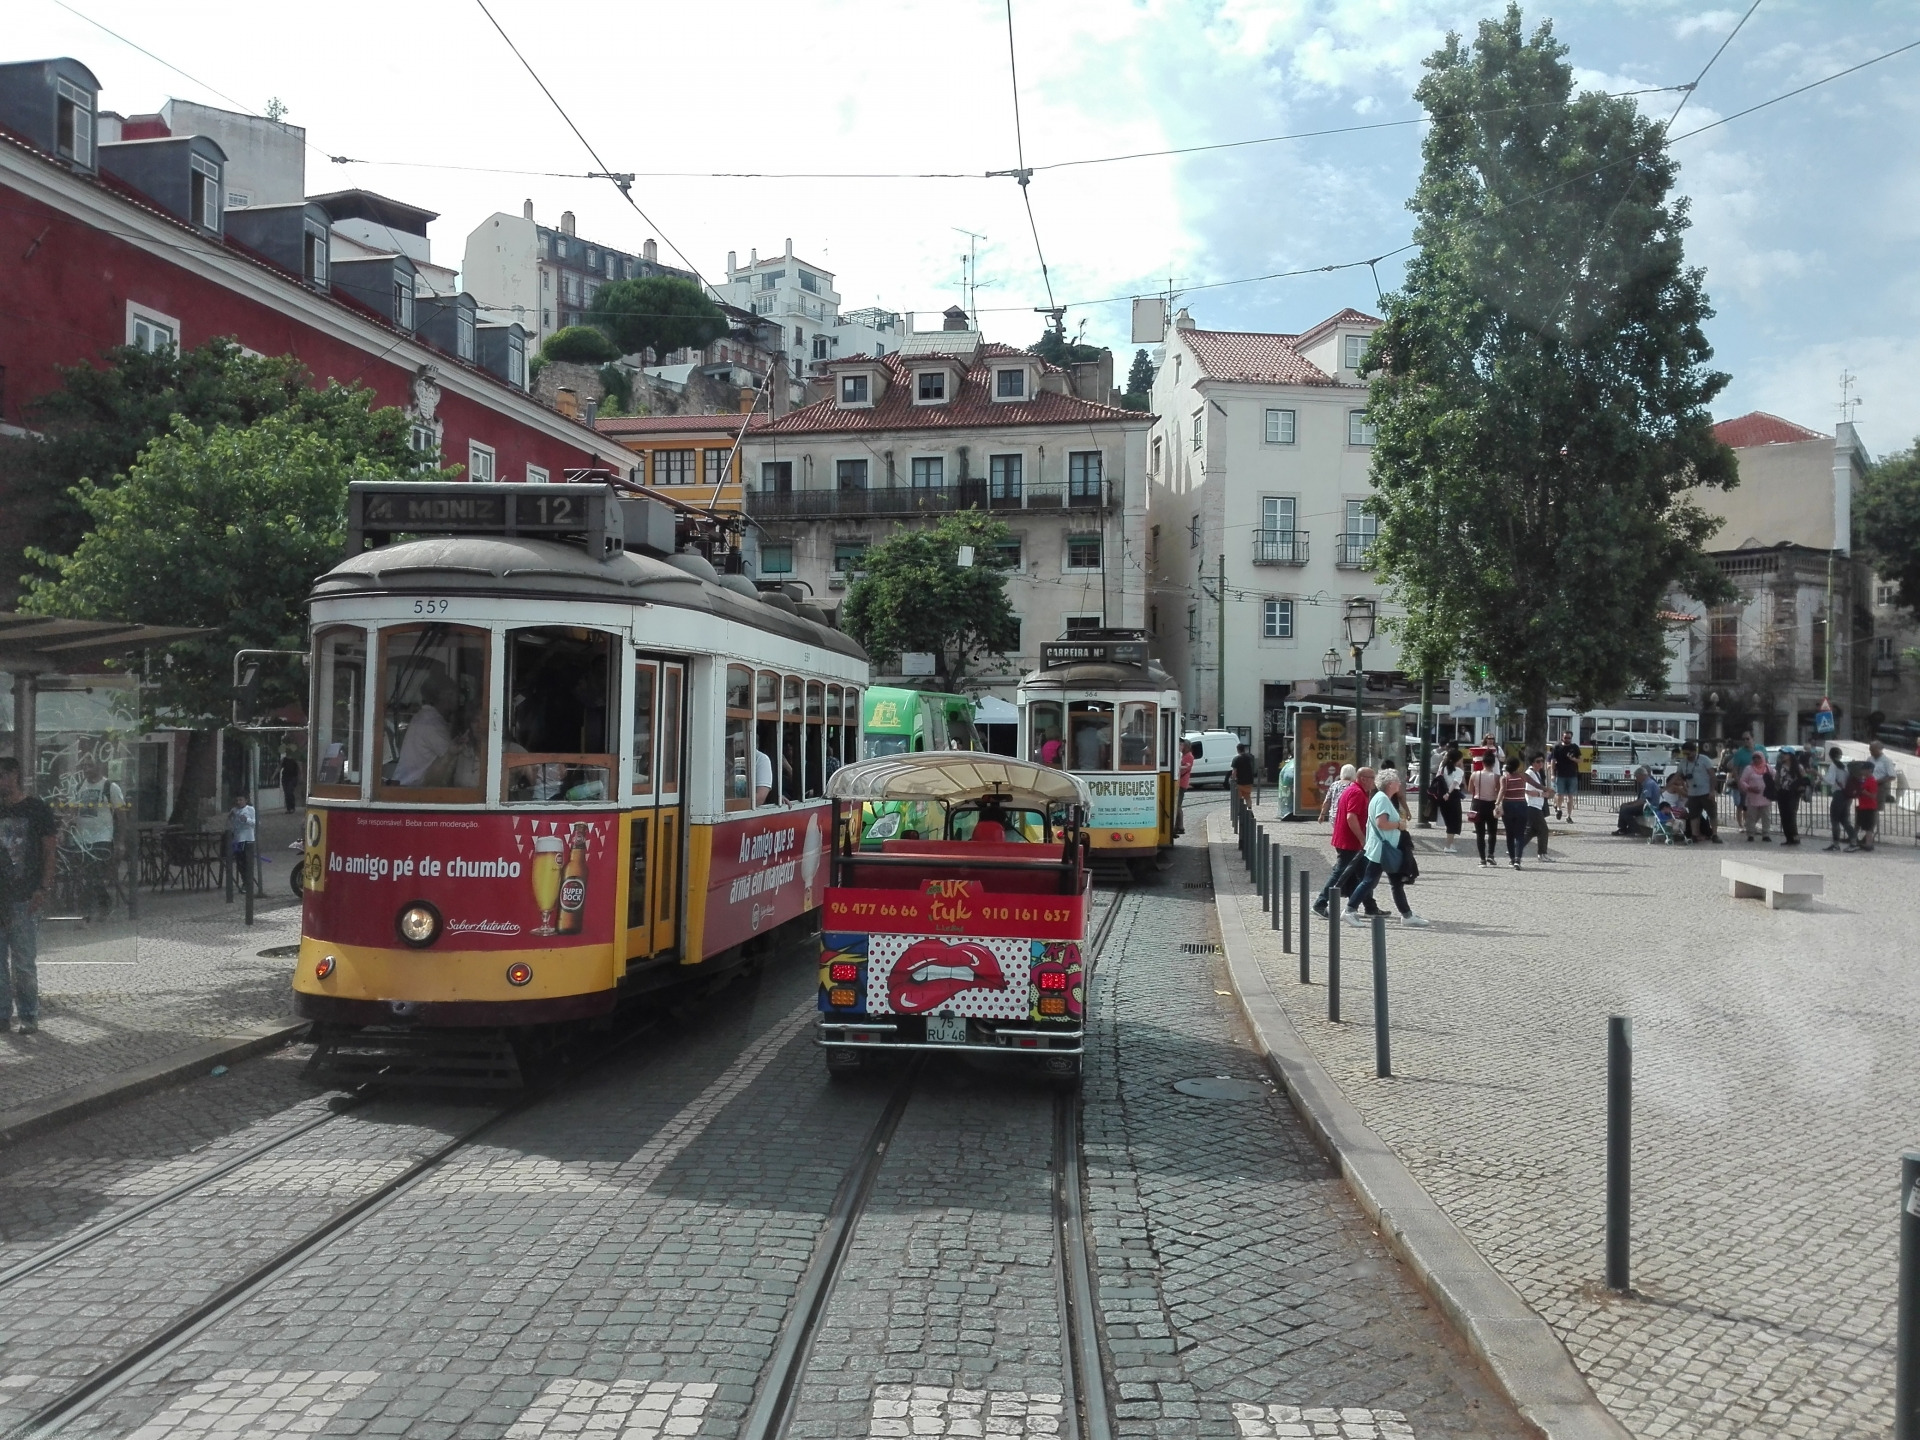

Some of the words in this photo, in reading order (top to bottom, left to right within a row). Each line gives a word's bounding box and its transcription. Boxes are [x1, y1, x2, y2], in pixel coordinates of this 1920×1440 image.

[408, 499, 496, 520] MONIZ
[537, 497, 573, 524] 12
[413, 600, 449, 614] 559
[1047, 648, 1089, 657] CARREIRA
[1309, 743, 1315, 751] A
[1089, 780, 1155, 797] PORTUGUESE
[405, 819, 422, 827] Beba
[739, 832, 750, 864] Ao
[751, 827, 773, 866] amigo
[774, 829, 786, 862] que
[786, 827, 795, 850] se
[329, 851, 342, 872] Ao
[345, 854, 388, 881] amigo
[393, 856, 414, 881] pé
[419, 856, 441, 877] de
[447, 857, 521, 878] chumbo
[730, 874, 751, 905] arma
[751, 871, 764, 896] em
[831, 902, 848, 914] 96
[852, 903, 876, 915] 477
[880, 904, 897, 916] 66
[901, 905, 918, 917] 66
[930, 900, 972, 923] tuk
[982, 907, 1009, 920] 910
[1015, 908, 1038, 921] 161
[1043, 909, 1071, 922] 637
[446, 918, 475, 930] Sabor
[941, 1018, 954, 1029] 75
[927, 1029, 945, 1041] RU
[951, 1030, 966, 1041] 46
